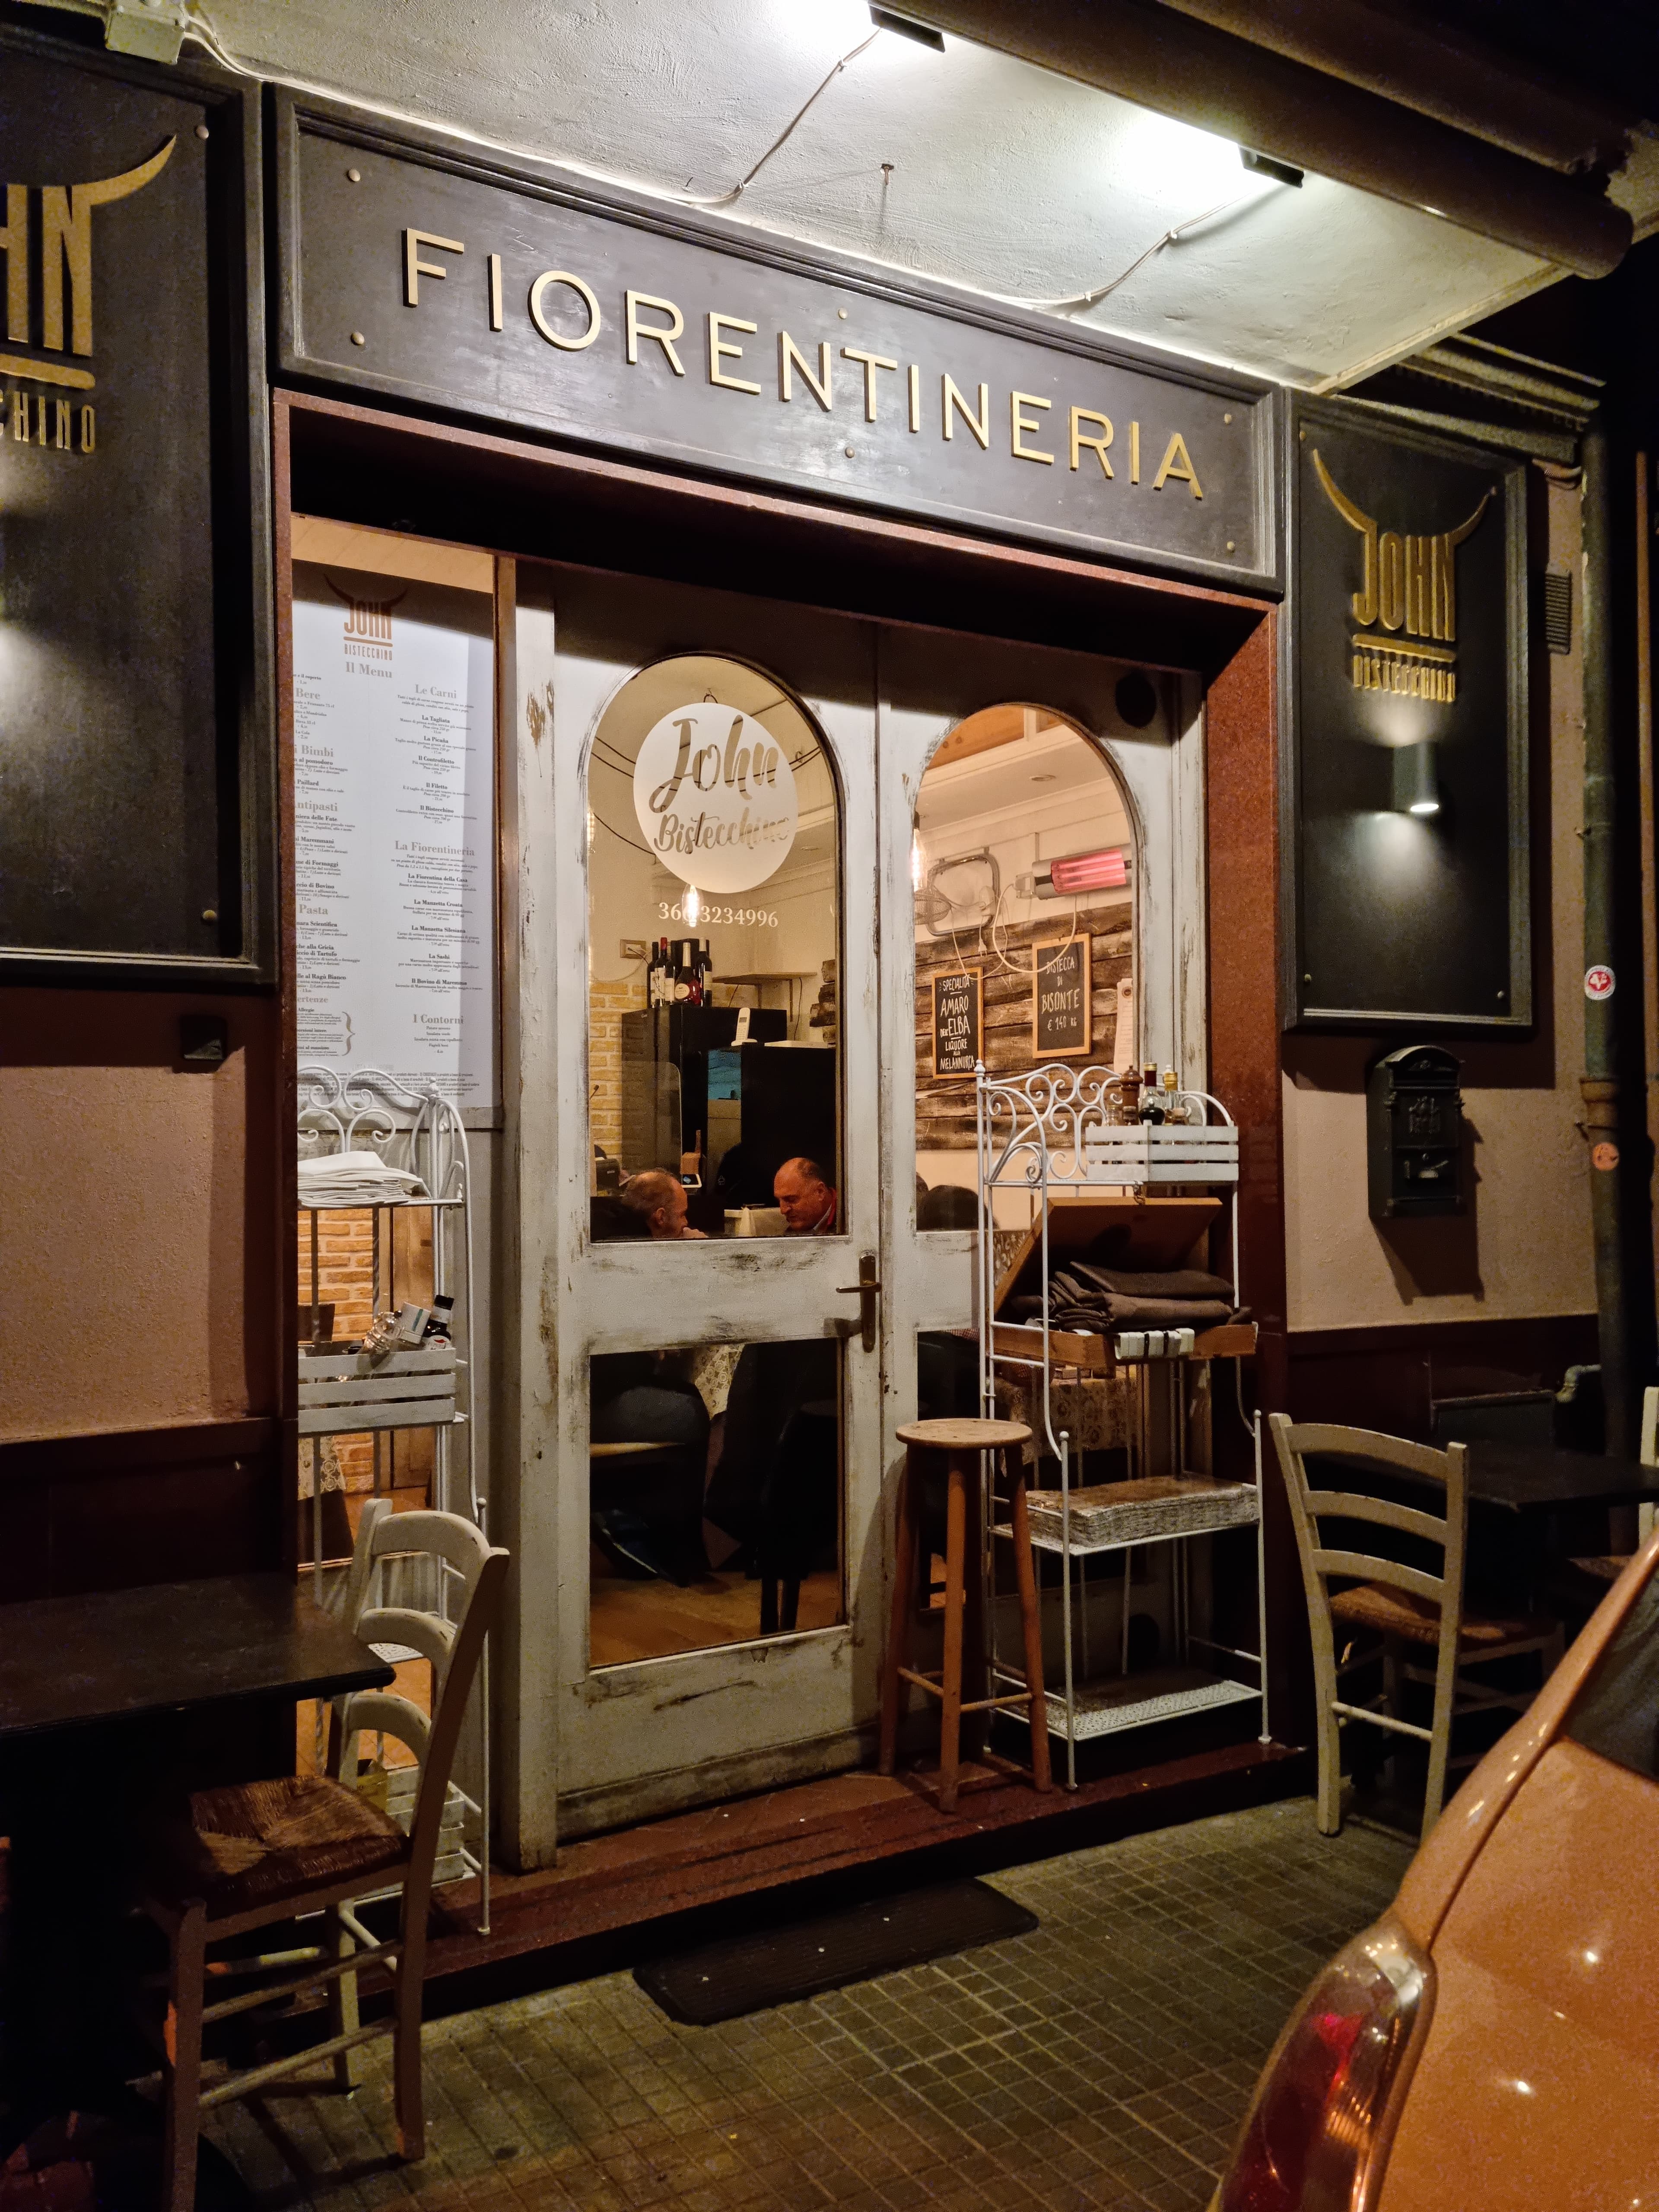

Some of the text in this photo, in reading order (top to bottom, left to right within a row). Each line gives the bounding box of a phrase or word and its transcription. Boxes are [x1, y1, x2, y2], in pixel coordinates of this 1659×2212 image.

[404, 228, 1203, 499] FIORENTINERIA
[0, 390, 95, 454] HINO
[1353, 519, 1456, 642] JOHN
[344, 600, 392, 640] JOHN
[344, 644, 392, 661] BISTECCHINO
[346, 661, 393, 679] Il Menu
[296, 687, 321, 699] Bere
[415, 684, 457, 699] Le Carni
[430, 716, 450, 724] Tagliata
[302, 745, 334, 757] Bimbi
[305, 757, 333, 767] pomodoro
[649, 715, 779, 814] John
[296, 801, 338, 813] ntipasti
[654, 807, 789, 855] Bistecchino
[395, 840, 474, 856] La Fiorentineria
[312, 860, 338, 868] Formaggi
[299, 904, 328, 915] Pasta
[700, 906, 778, 928] 3234996
[1057, 976, 1063, 987] DI
[940, 995, 969, 1017] AMARO
[1042, 988, 1080, 1014] BISONTE
[413, 1014, 463, 1024] I Contorni
[948, 1015, 970, 1036] ELBA
[1048, 1019, 1052, 1031] €
[1055, 1016, 1066, 1030] 140
[945, 1039, 967, 1051] LIQUORE
